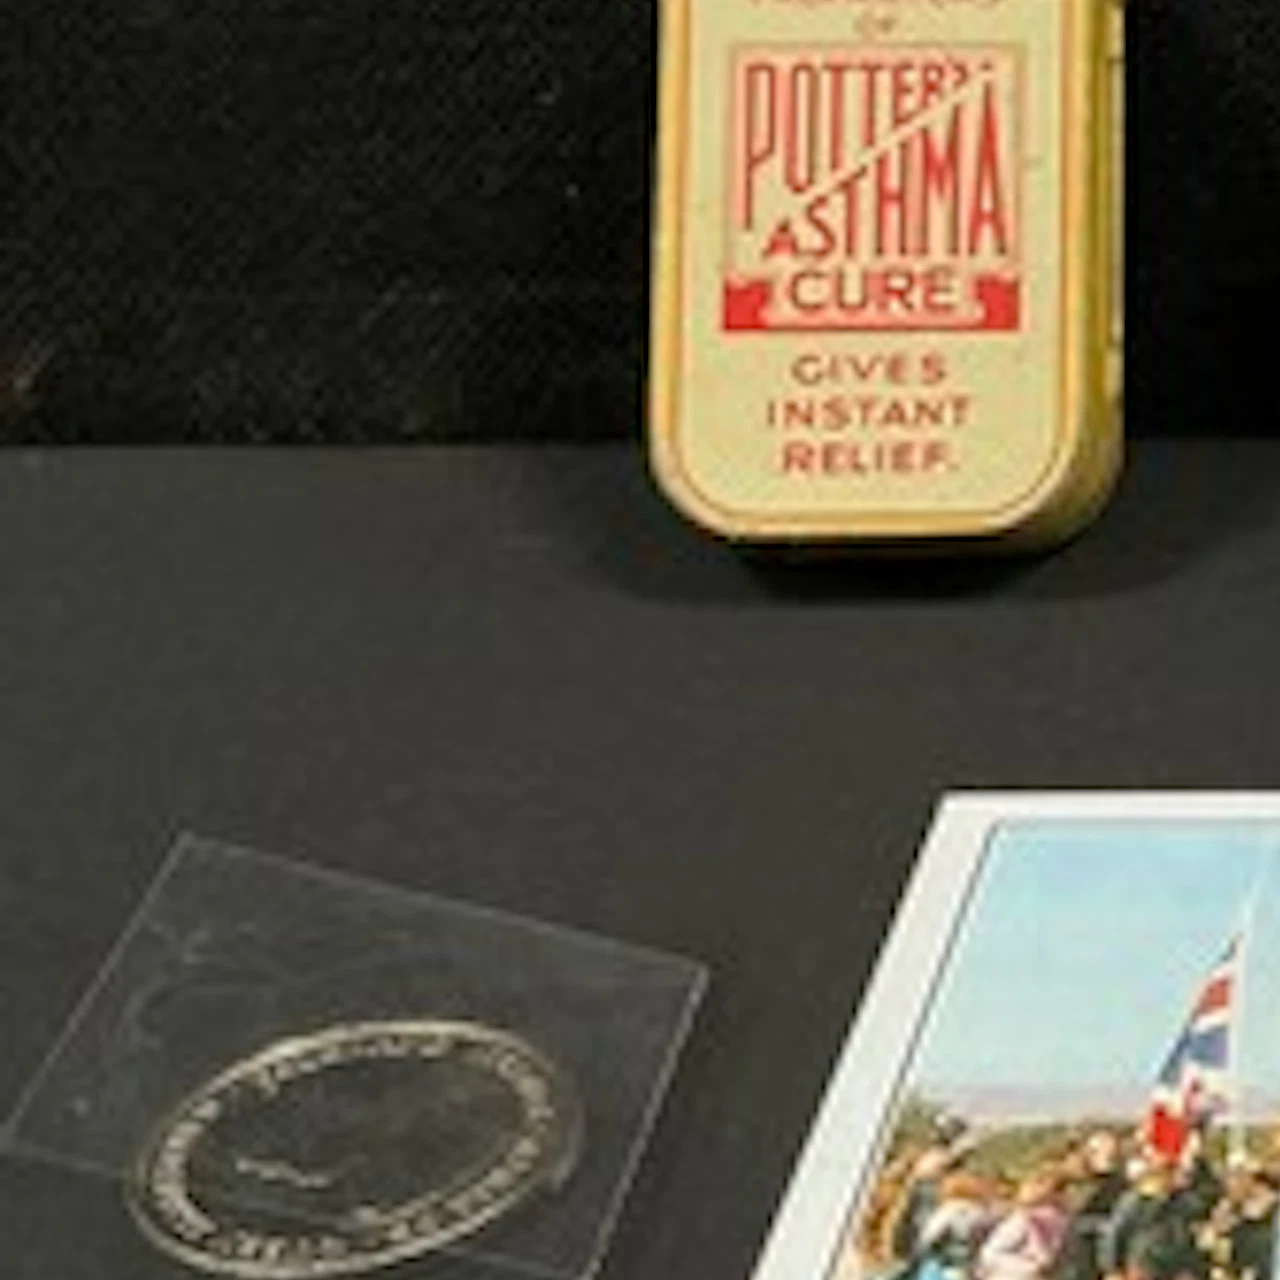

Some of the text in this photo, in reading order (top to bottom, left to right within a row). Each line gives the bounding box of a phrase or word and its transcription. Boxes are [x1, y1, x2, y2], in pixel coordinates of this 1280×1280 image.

[760, 62, 1007, 260] ASTHMA
[789, 269, 958, 312] CURE
[791, 354, 947, 386] GIVES
[767, 396, 972, 428] INSTANT
[782, 440, 961, 474] RELIEF.
